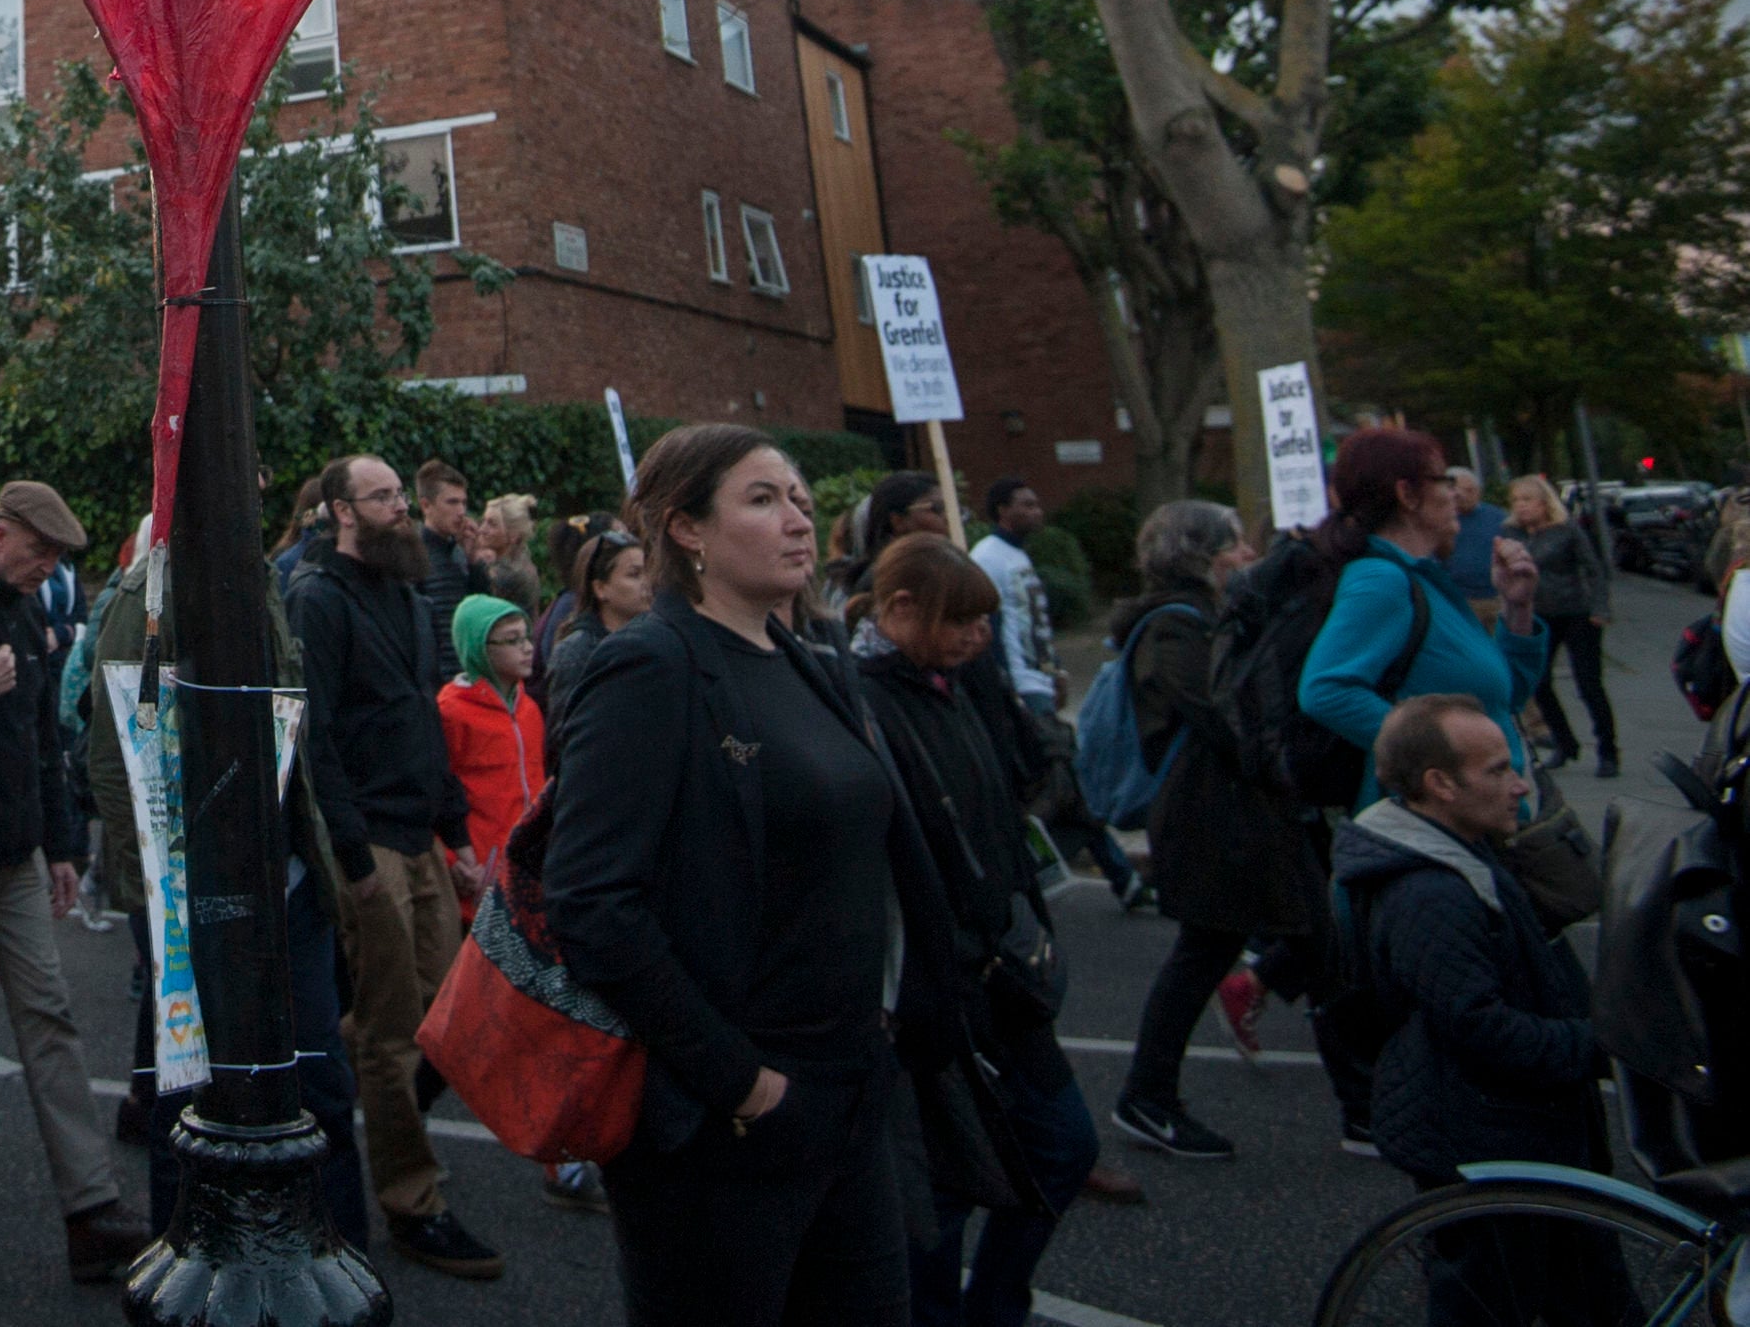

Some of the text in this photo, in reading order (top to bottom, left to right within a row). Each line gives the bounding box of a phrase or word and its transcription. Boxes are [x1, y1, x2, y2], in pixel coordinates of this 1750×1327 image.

[877, 262, 926, 289] Justice
[895, 292, 919, 317] for
[882, 320, 941, 346] Grenfell
